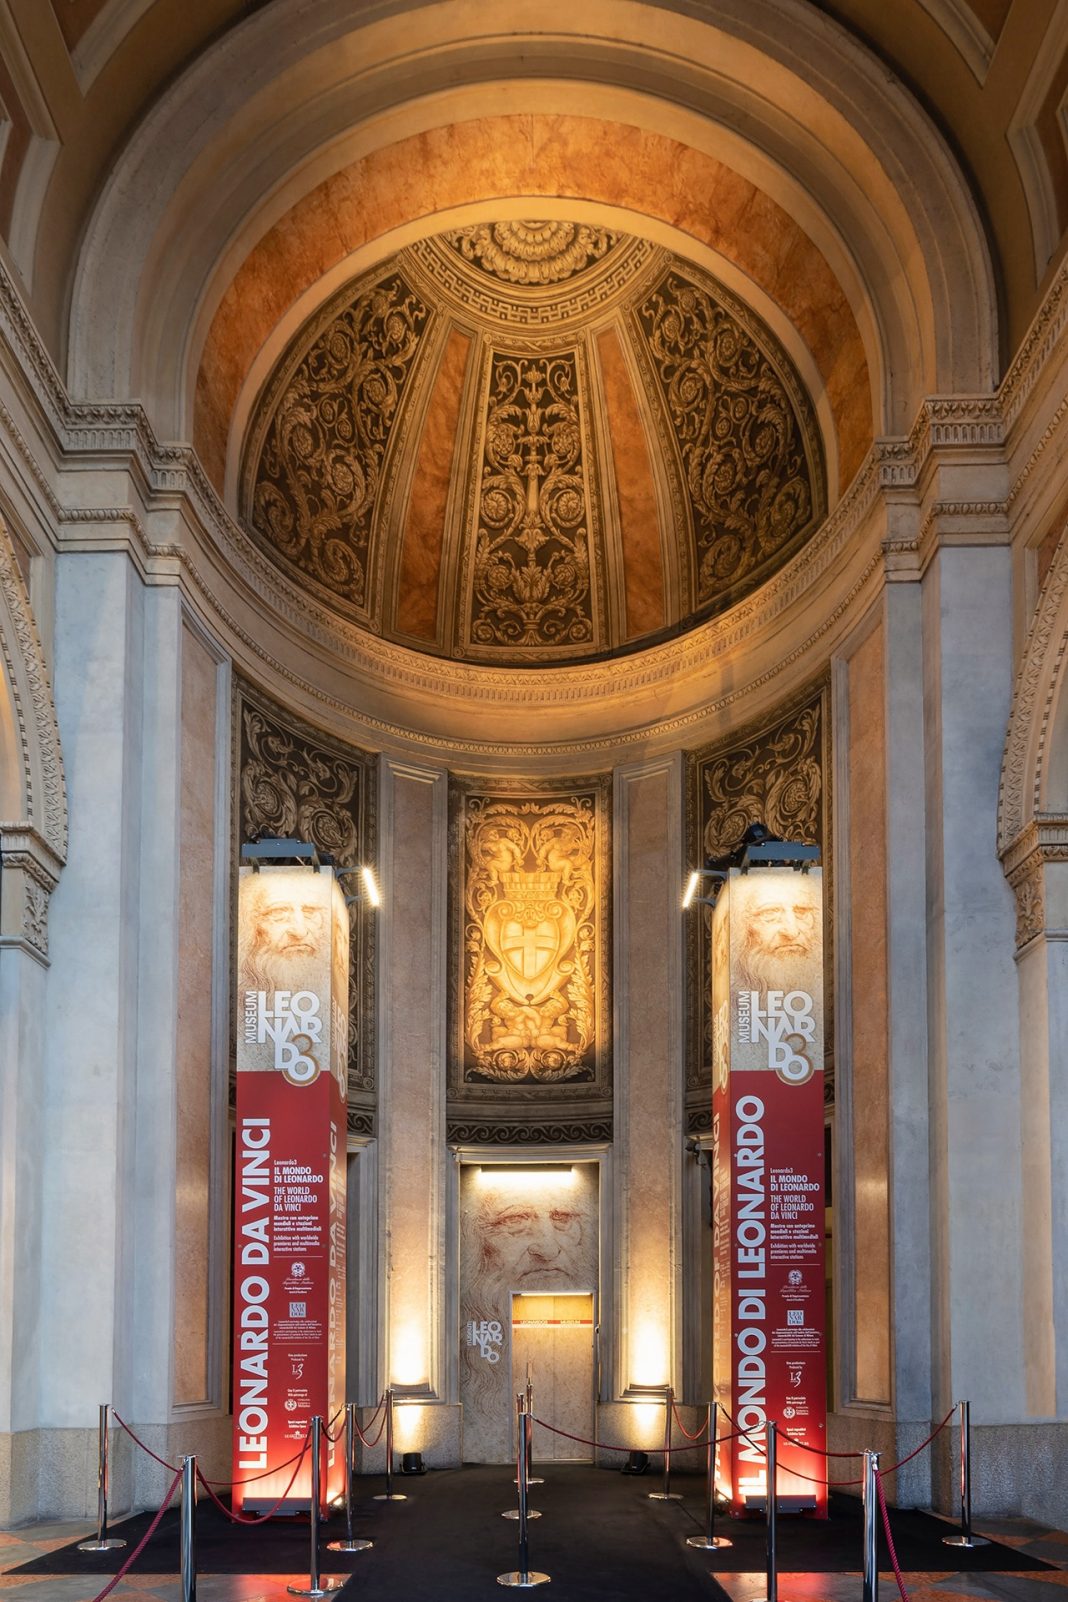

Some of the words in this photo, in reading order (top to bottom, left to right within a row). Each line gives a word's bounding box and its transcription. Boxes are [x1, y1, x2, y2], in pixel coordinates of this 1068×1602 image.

[244, 990, 258, 1044] MUSEUM
[258, 990, 320, 1018] LEO
[738, 990, 750, 1043] MUSEUM
[751, 990, 813, 1018] LEO
[258, 1014, 322, 1043] NAR
[751, 1014, 816, 1042] NAR
[242, 1118, 270, 1212] VINCI
[736, 1095, 766, 1278] LEONARDO
[242, 1216, 270, 1265] DA
[330, 1222, 336, 1267] DA
[714, 1201, 720, 1248] DA
[472, 1321, 502, 1334] LEO
[738, 1289, 766, 1320] DI
[472, 1332, 502, 1346] NAR
[239, 1276, 270, 1469] LEONARDO
[328, 1278, 336, 1468] LEONARDO
[738, 1327, 767, 1463] MONDO
[738, 1470, 766, 1496] IL
